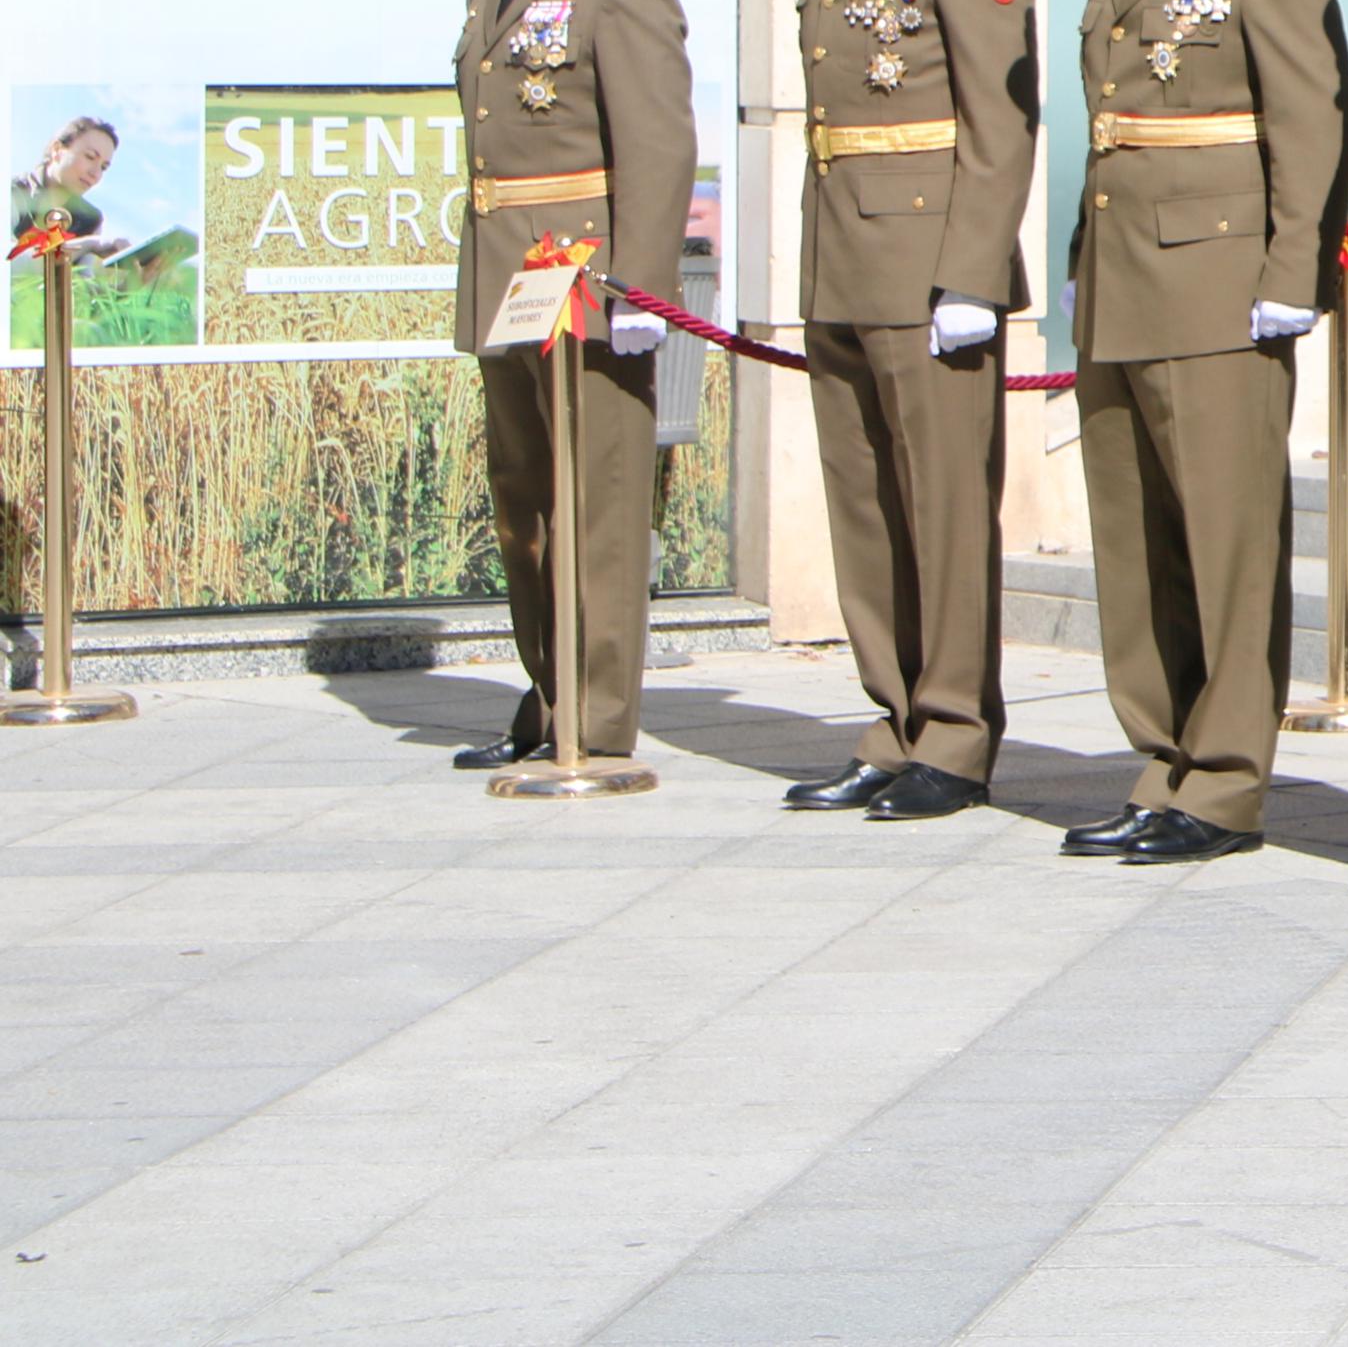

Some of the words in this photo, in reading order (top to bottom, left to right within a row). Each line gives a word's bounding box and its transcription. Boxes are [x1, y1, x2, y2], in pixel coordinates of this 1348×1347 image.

[289, 274, 333, 285] nueva
[338, 273, 361, 284] era
[366, 272, 428, 286] empieza
